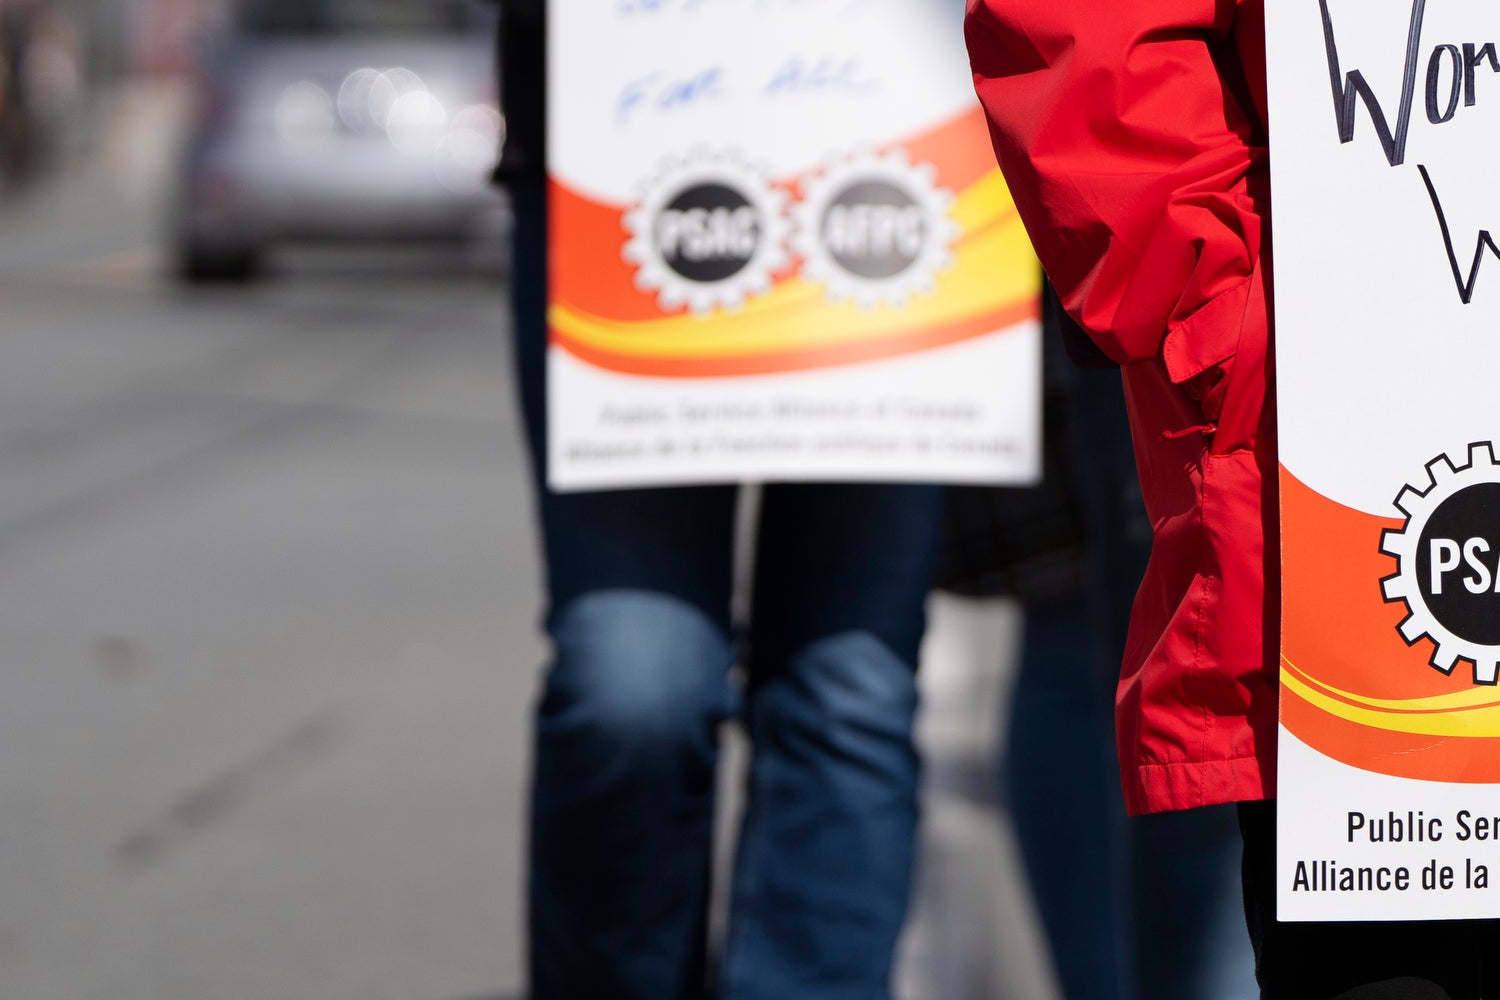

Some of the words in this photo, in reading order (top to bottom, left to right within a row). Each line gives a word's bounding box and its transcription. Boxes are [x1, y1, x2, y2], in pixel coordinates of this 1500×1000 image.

[656, 203, 761, 261] PSAC
[825, 202, 926, 259] AFPC
[1347, 810, 1443, 843] Public
[1292, 860, 1410, 892] Alliance
[1421, 859, 1454, 891] de
[1465, 858, 1488, 889] la
